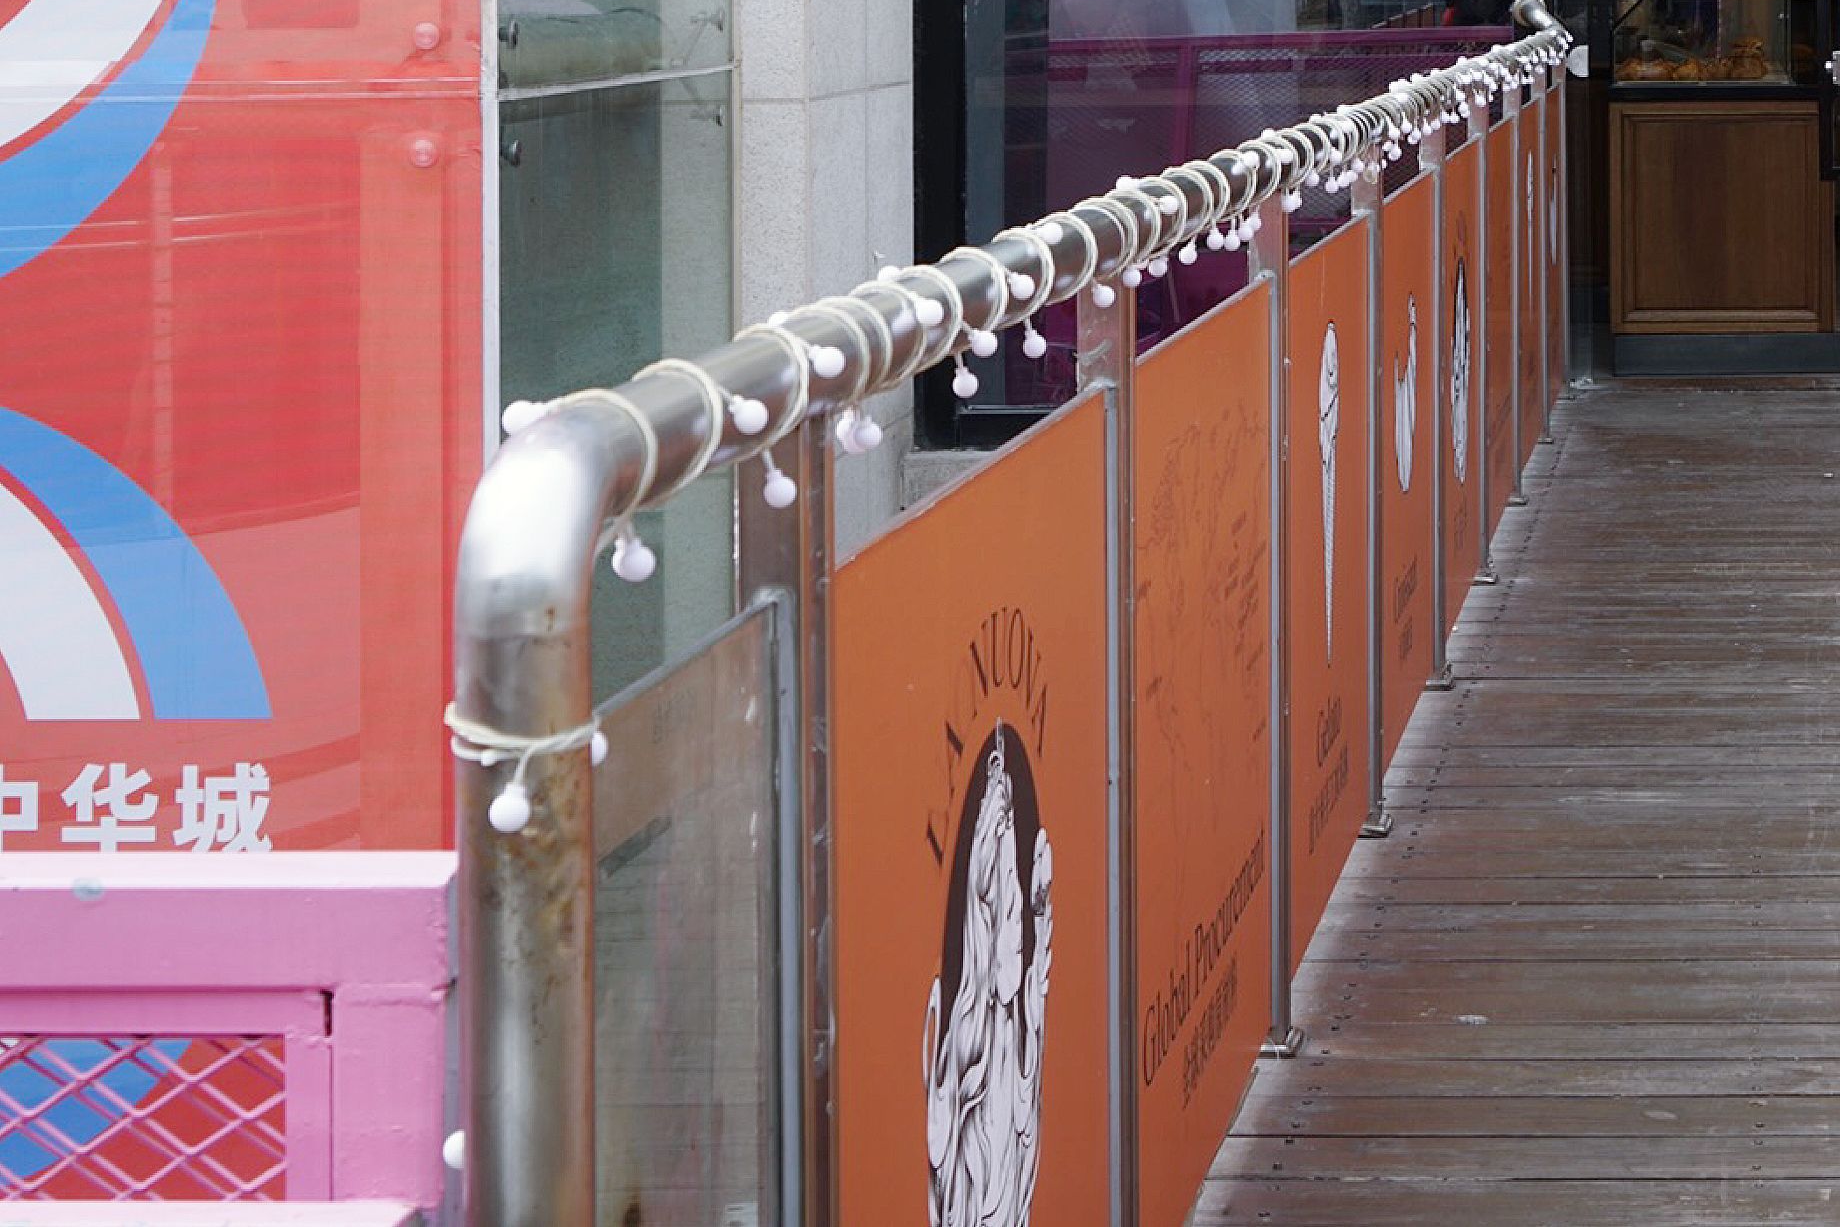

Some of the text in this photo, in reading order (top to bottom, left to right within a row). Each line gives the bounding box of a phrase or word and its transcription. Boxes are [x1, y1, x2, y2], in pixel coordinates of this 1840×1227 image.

[926, 606, 1048, 867] LA NUOVA
[1143, 939, 1191, 1088] Global
[1194, 825, 1265, 998] Procurement
